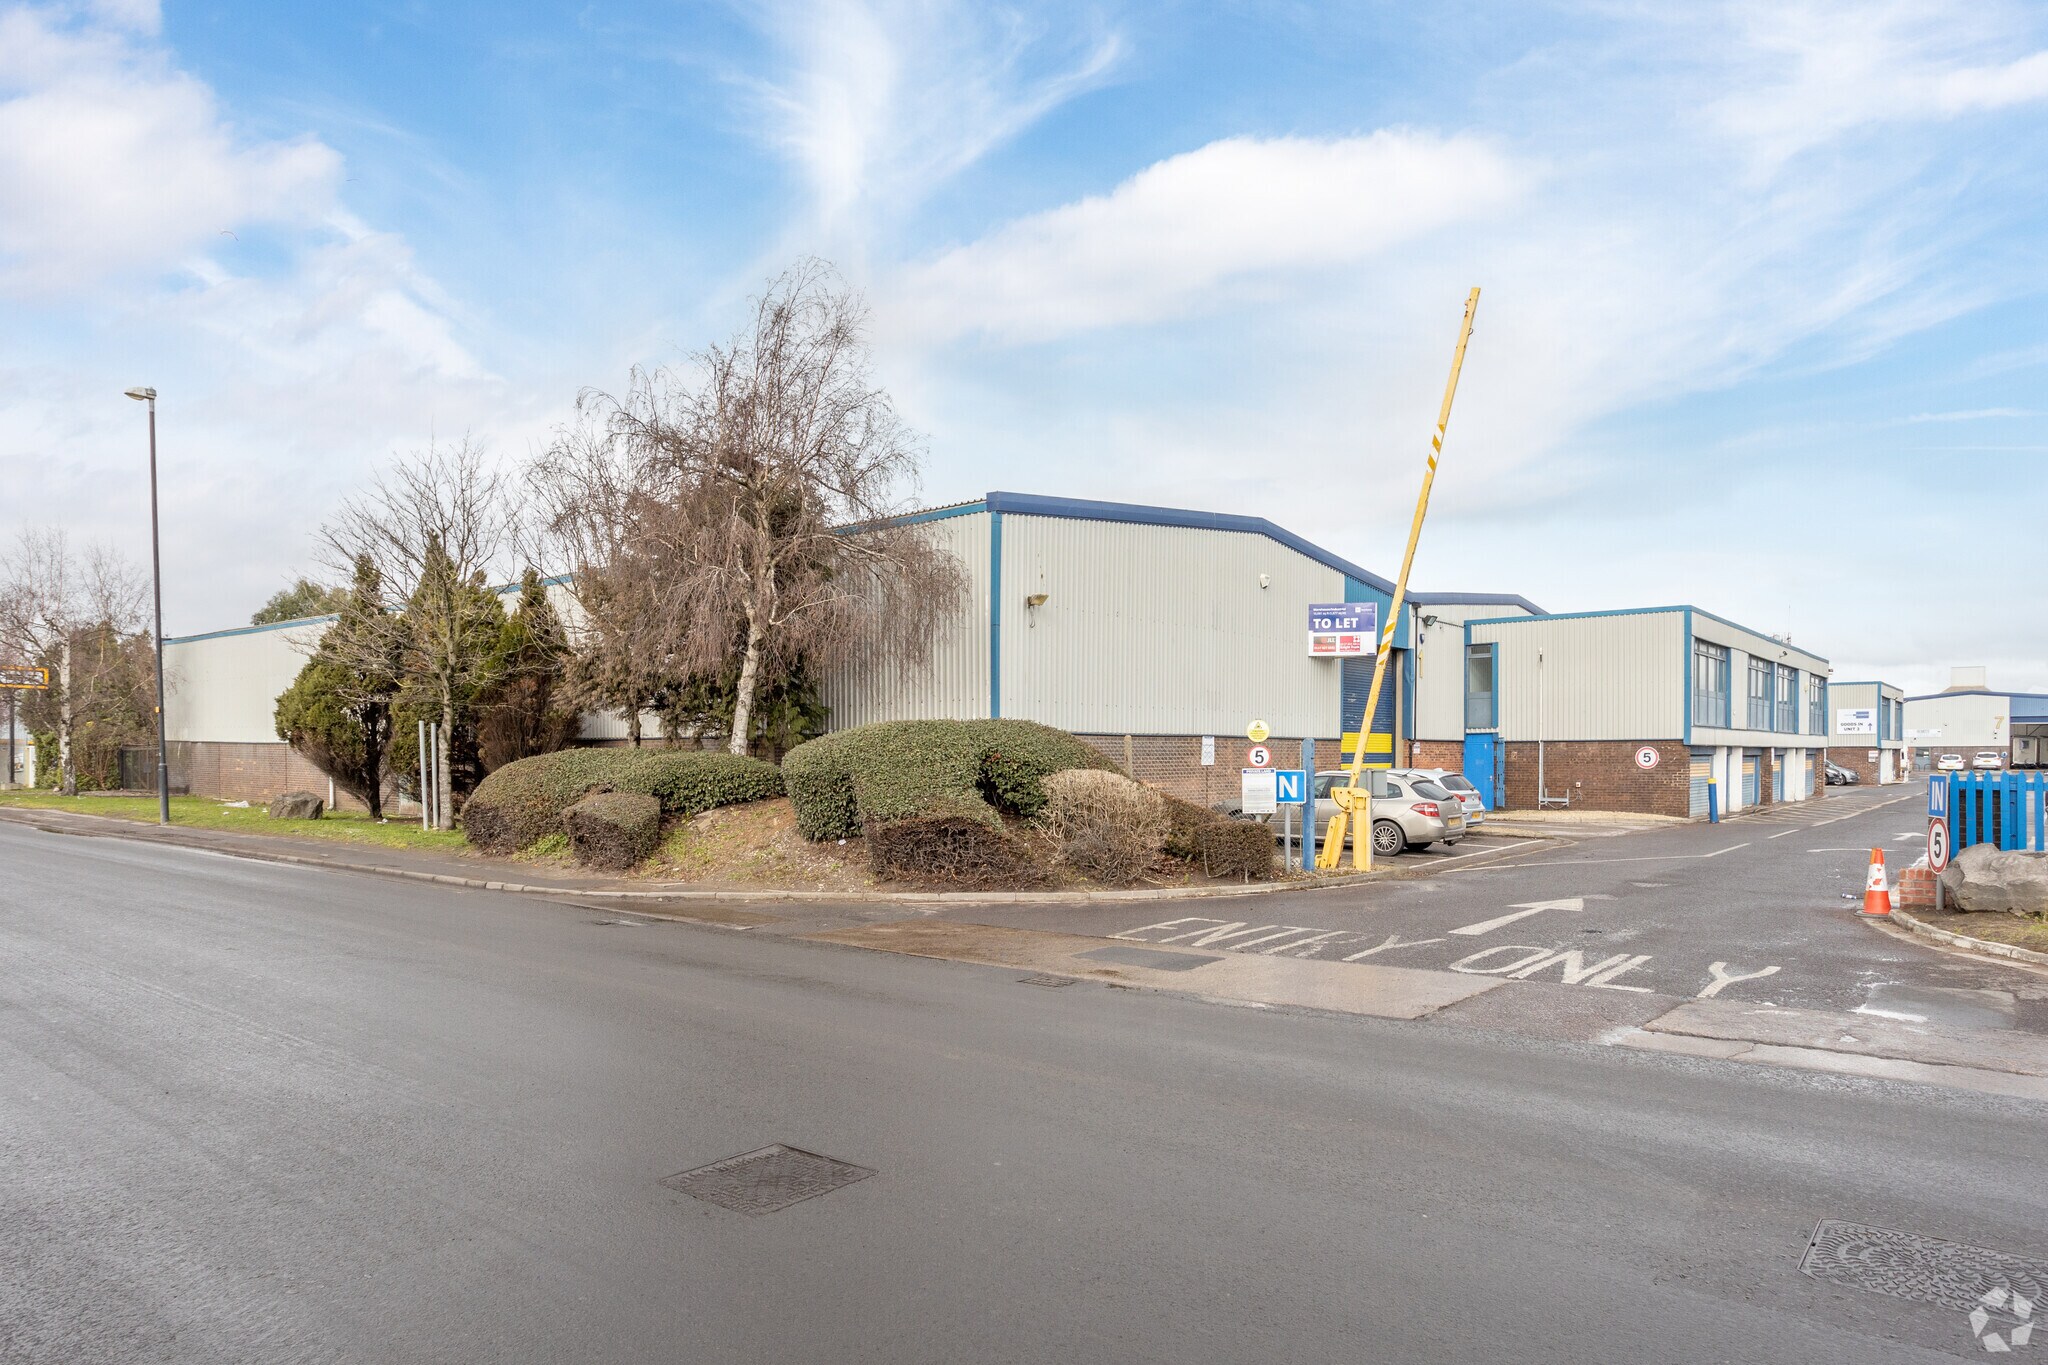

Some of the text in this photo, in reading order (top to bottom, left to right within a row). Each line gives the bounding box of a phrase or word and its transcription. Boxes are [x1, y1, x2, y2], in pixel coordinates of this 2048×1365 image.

[1313, 617, 1359, 629] TO LET
[1994, 716, 2004, 729] 7
[1255, 750, 1264, 764] 5
[1643, 753, 1651, 763] 5
[1931, 781, 1944, 811] IN
[1934, 832, 1941, 858] 5
[1106, 917, 1447, 961] ENTRY
[1449, 945, 1781, 998] ONLY
